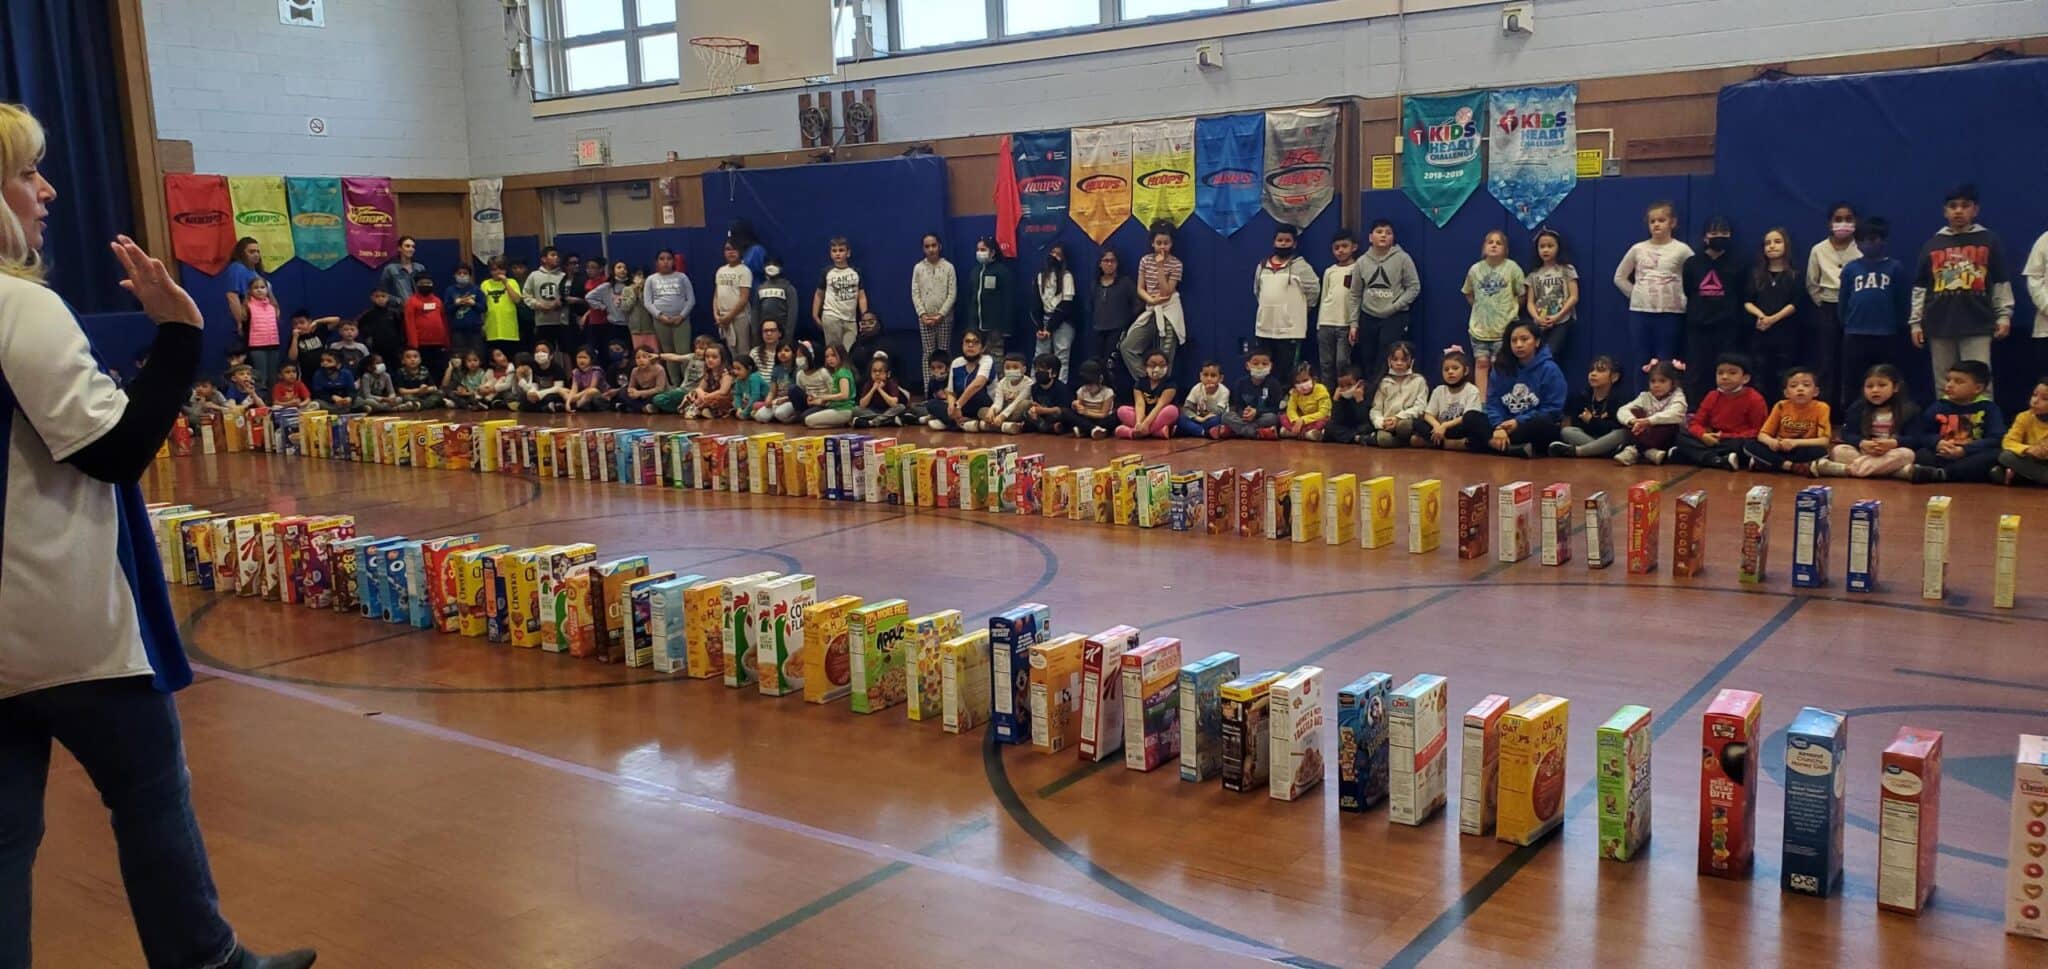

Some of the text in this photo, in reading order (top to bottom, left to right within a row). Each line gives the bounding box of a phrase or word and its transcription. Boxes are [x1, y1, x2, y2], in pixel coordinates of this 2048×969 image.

[1521, 111, 1567, 129] KIDS
[1429, 121, 1476, 143] KIDS
[1147, 175, 1185, 186] HOOPS
[1854, 272, 1891, 292] GAP
